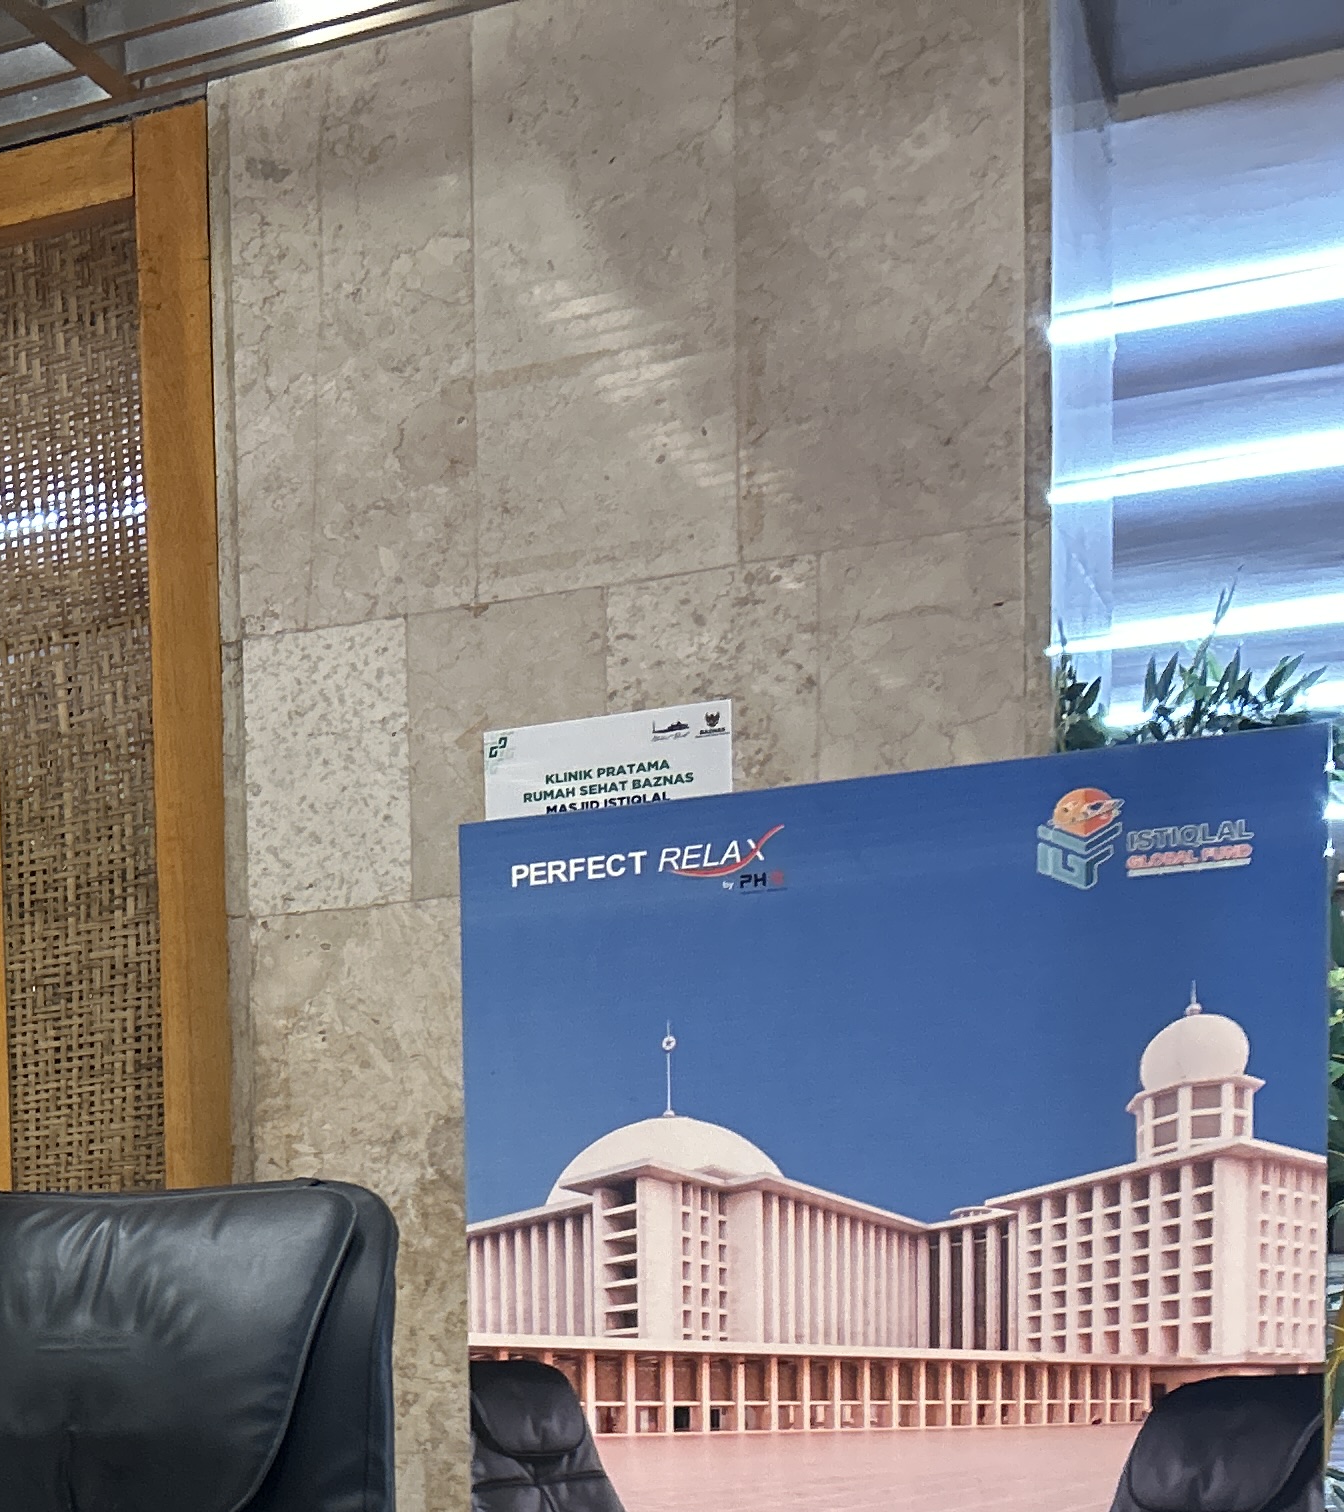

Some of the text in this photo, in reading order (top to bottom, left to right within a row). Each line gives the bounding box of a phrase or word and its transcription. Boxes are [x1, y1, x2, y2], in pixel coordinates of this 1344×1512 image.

[523, 772, 694, 803] RUMAH SEHAT BAZNAS
[545, 759, 670, 785] KLINIK PRATAMA
[1126, 819, 1255, 852] ISTIQLAL
[511, 831, 774, 888] PERFECT RELAX
[722, 879, 734, 891] by
